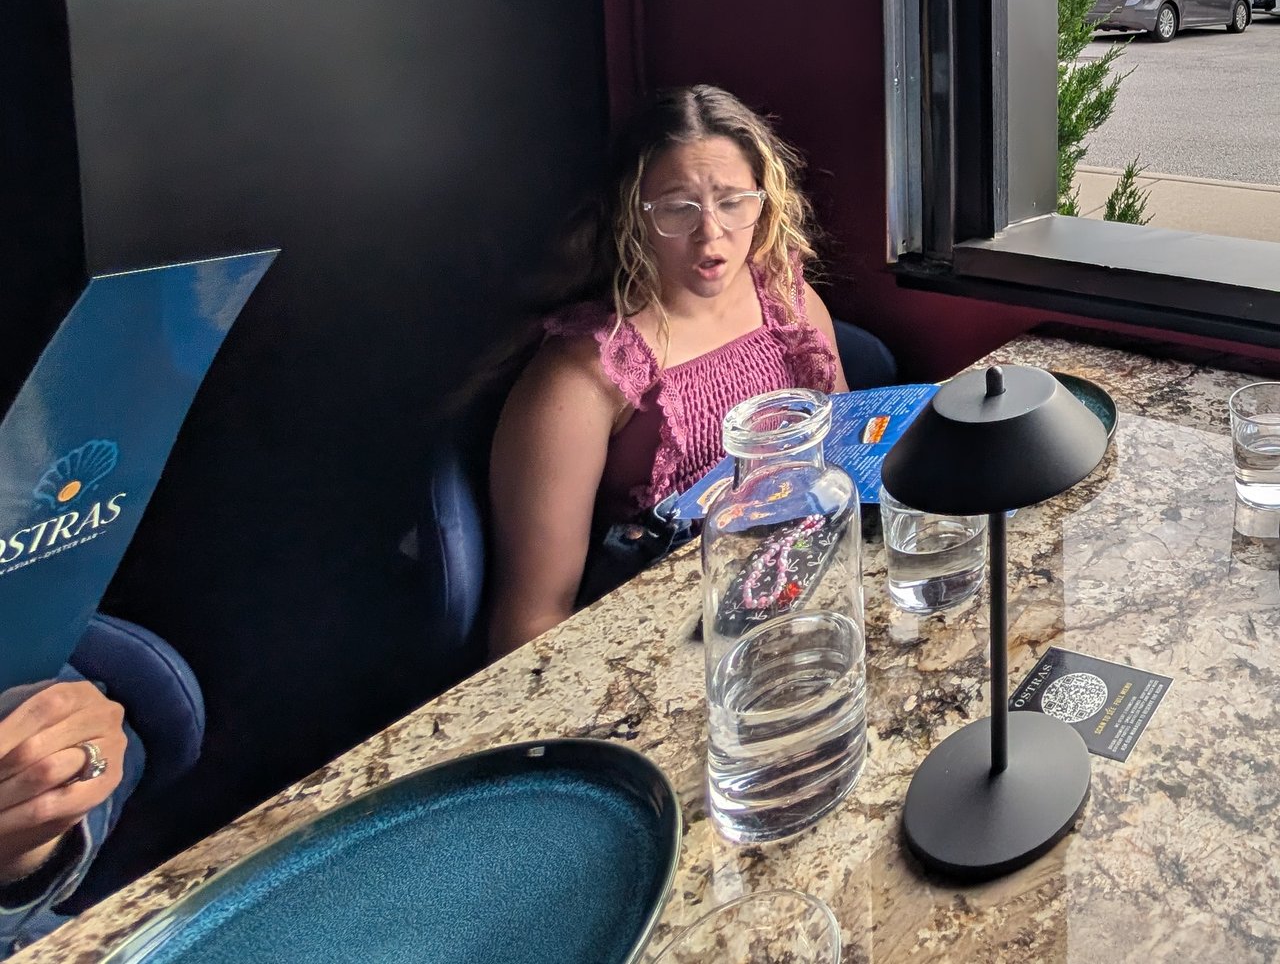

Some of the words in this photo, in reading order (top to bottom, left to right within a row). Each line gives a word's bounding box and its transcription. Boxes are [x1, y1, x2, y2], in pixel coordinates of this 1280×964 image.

[0, 493, 126, 563] STRAS
[44, 540, 79, 558] OYSTER
[1014, 664, 1052, 707] OSTRAS
